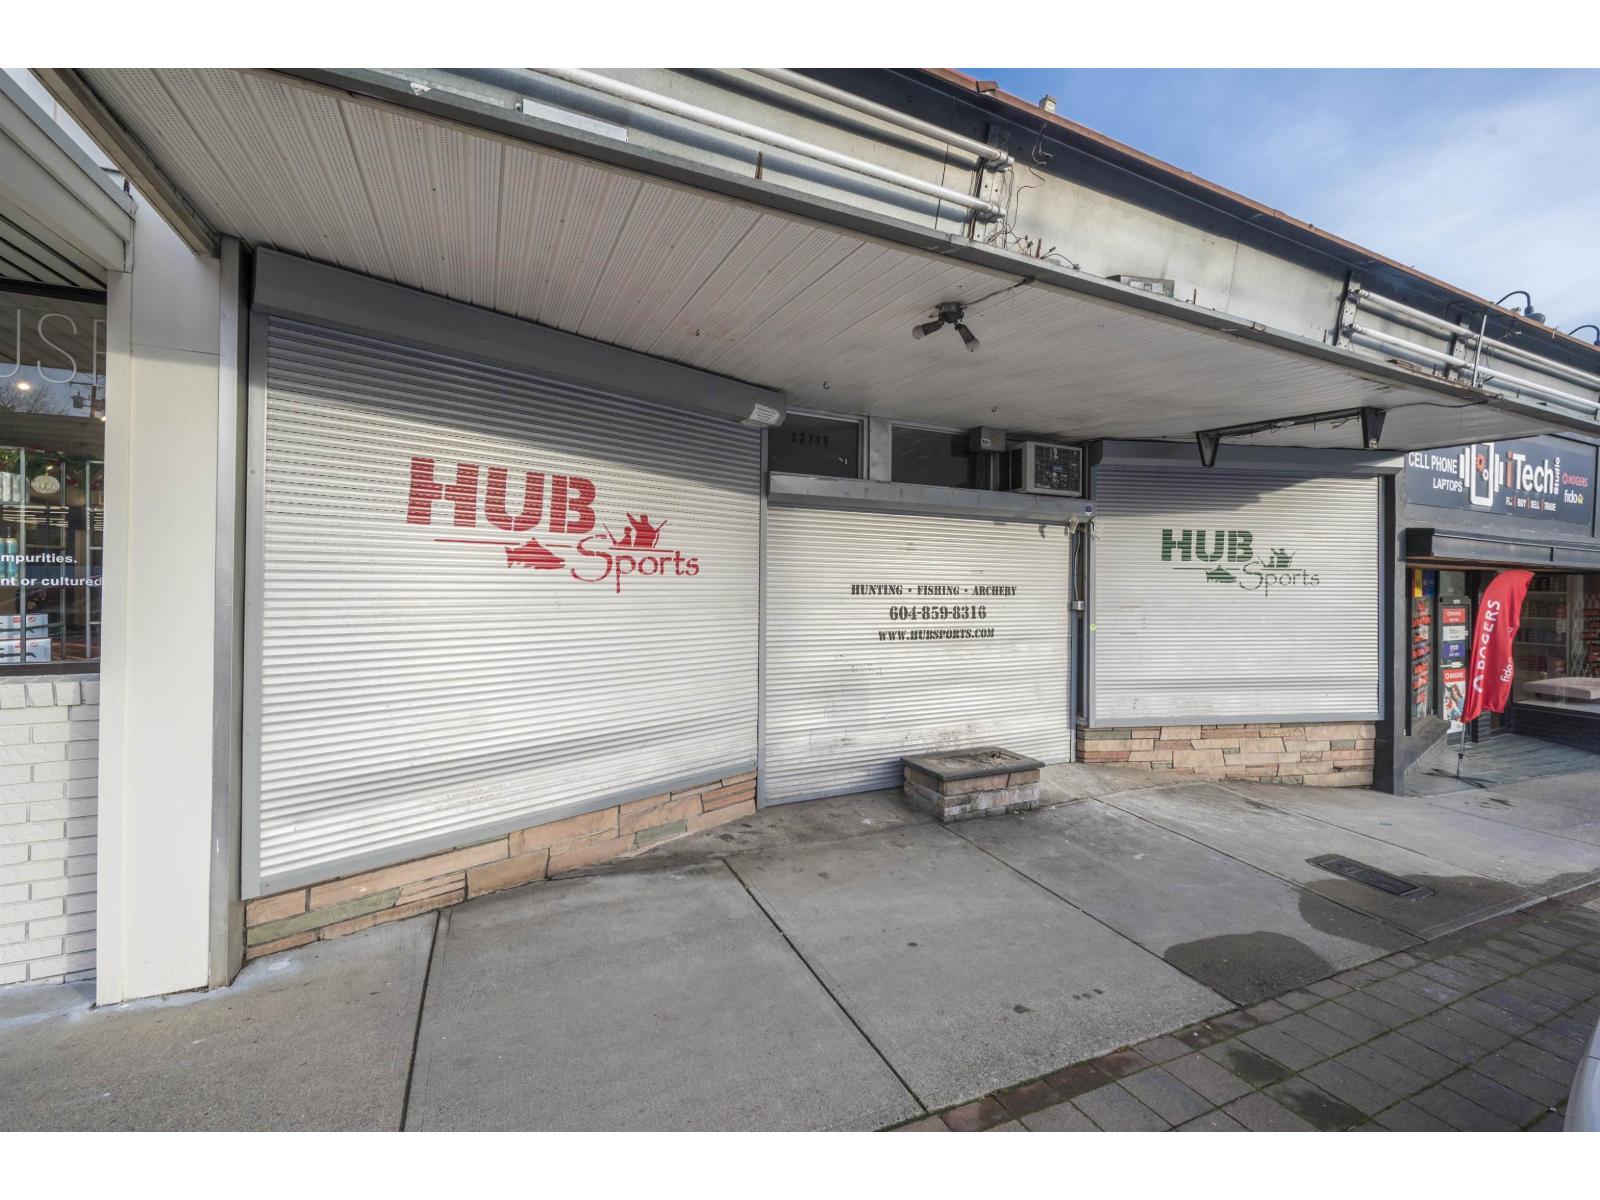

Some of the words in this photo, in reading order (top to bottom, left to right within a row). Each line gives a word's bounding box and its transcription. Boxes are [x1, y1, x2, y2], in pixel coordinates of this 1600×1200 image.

[1408, 452, 1430, 469] CELL
[1431, 455, 1458, 474] PHONE
[1506, 451, 1553, 494] iTech
[406, 456, 596, 534] HUB
[1432, 477, 1463, 492] LAPTOPS
[1161, 529, 1253, 562] HUB
[570, 534, 699, 594] Sports
[20, 578, 38, 586] or
[41, 576, 103, 586] cultured
[1239, 561, 1320, 597] Sports
[850, 584, 903, 596] HUNTING
[917, 585, 960, 596] FISHING
[972, 585, 1017, 597] ARCHERY
[889, 605, 987, 620] 604-859-8316
[878, 628, 995, 641] WWW.HUBSPORTS.COM
